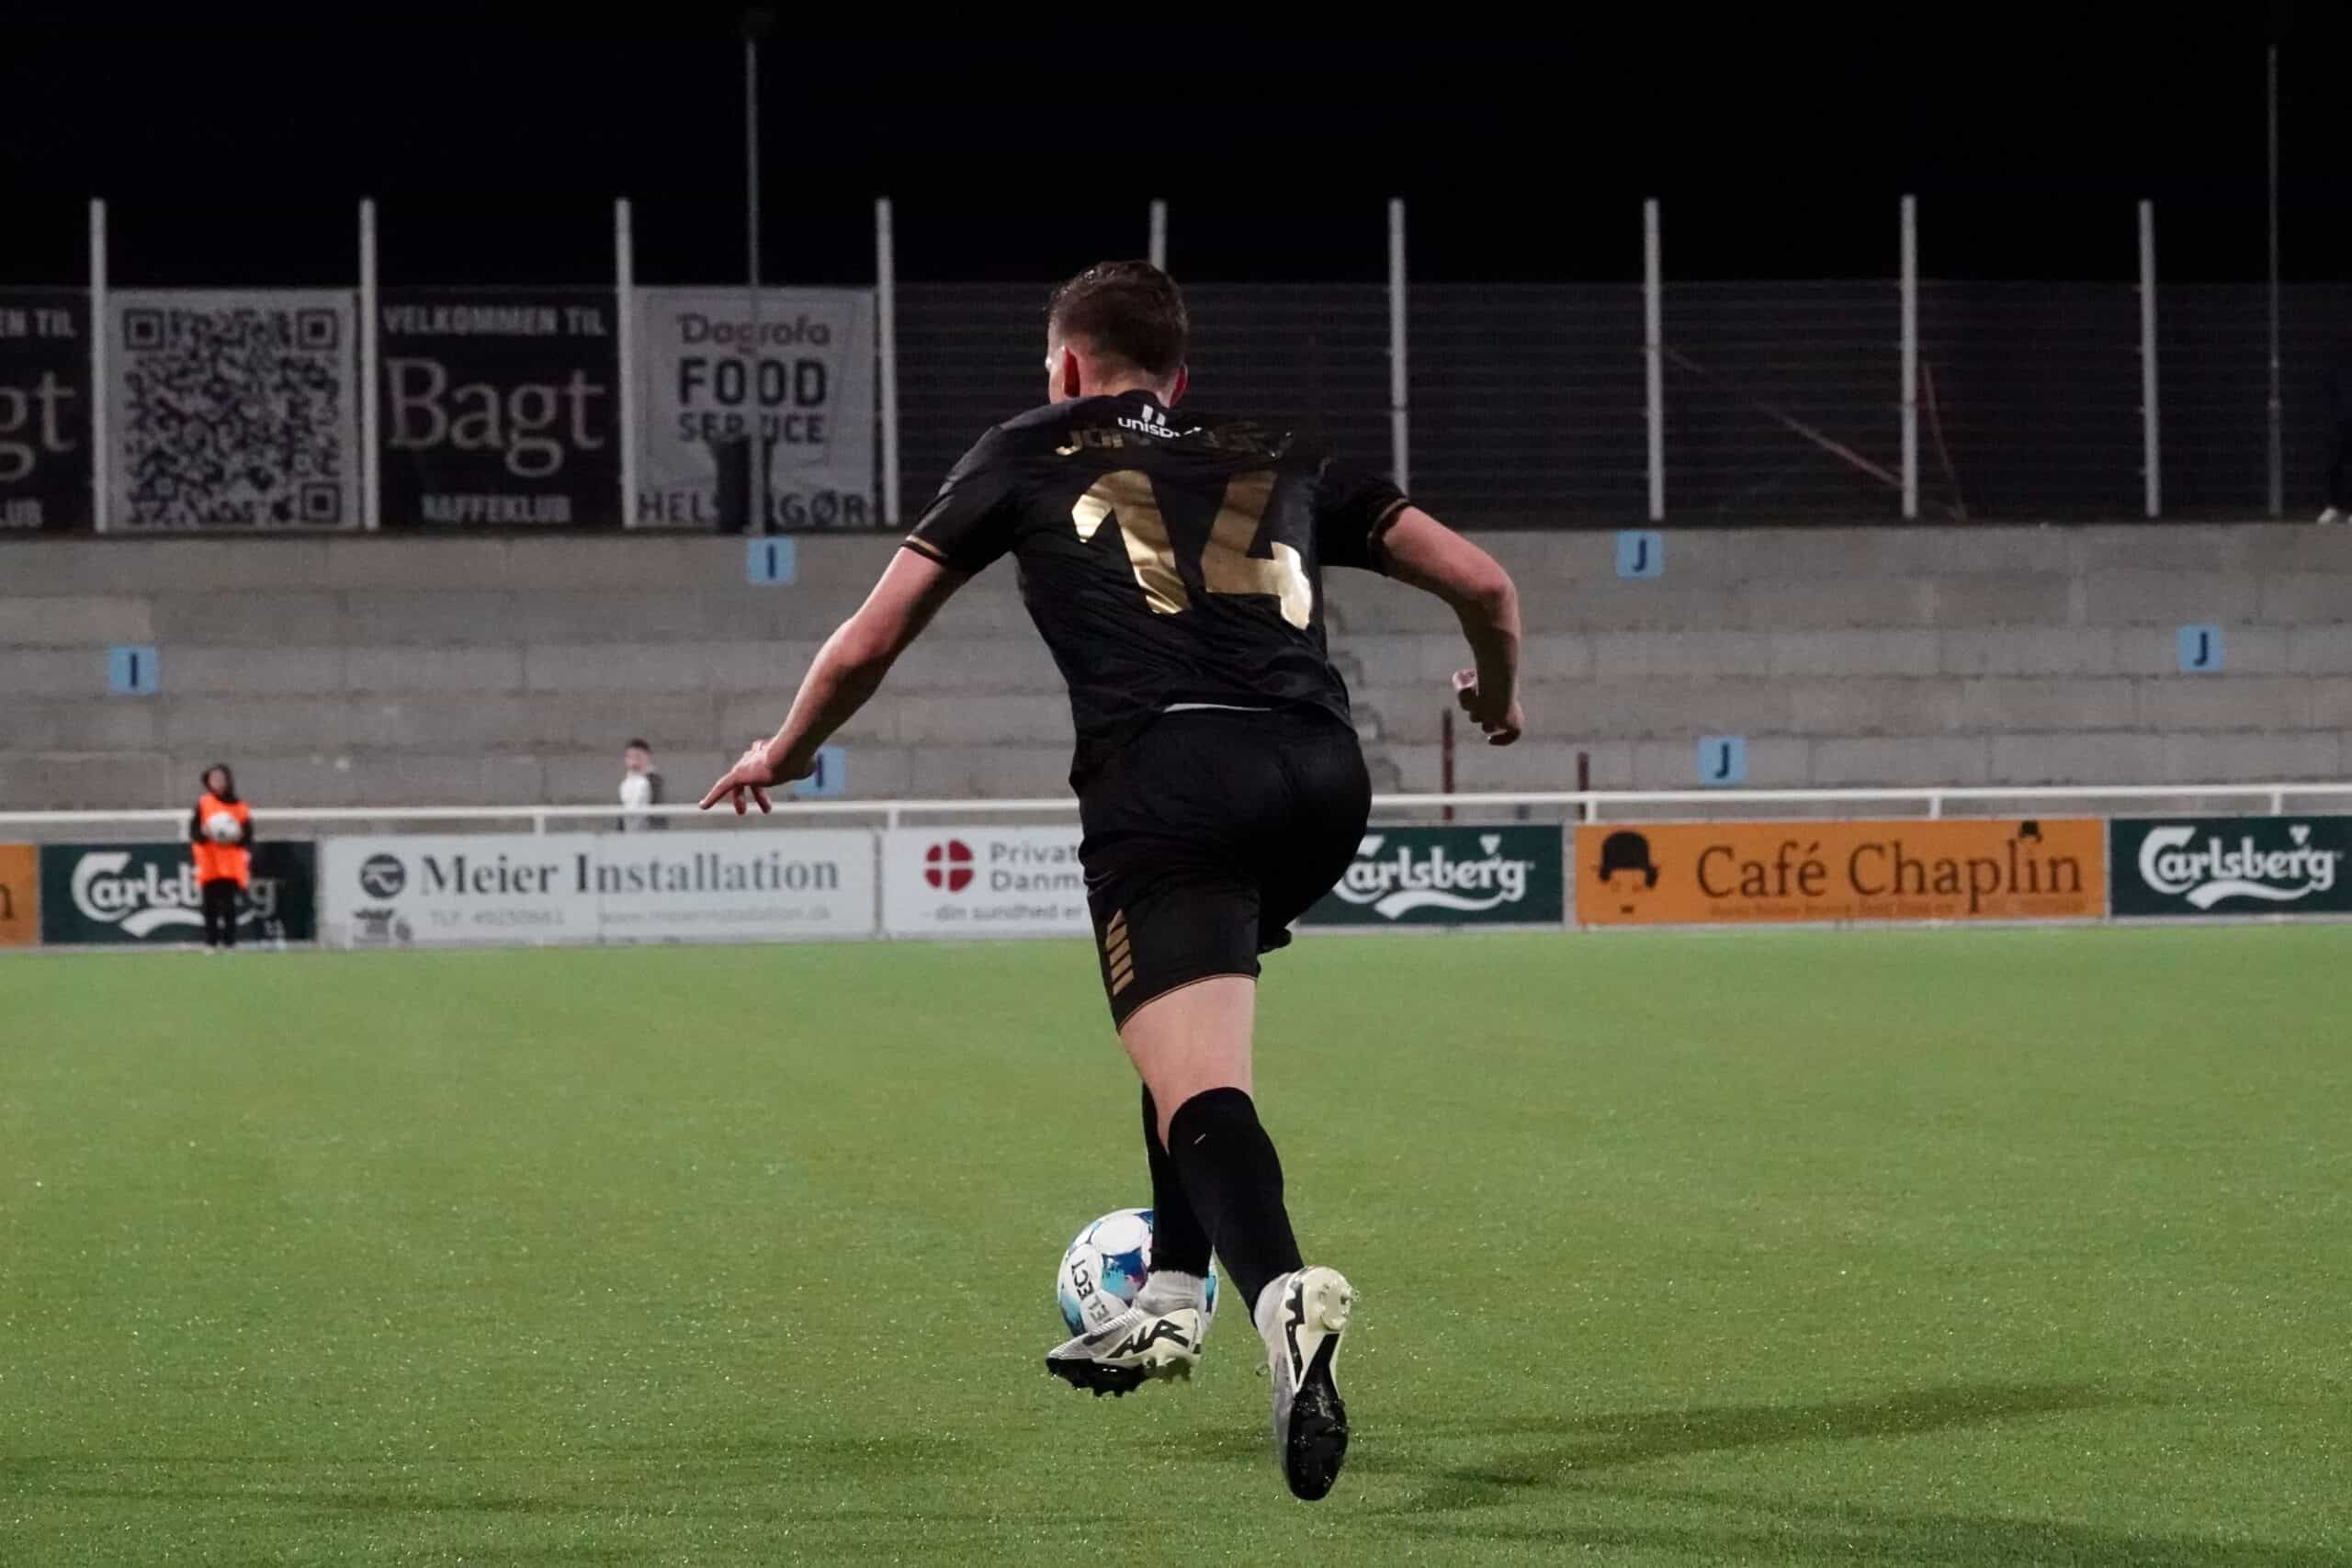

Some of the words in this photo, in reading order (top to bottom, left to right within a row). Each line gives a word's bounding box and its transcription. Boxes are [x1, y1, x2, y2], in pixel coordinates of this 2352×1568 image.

[382, 306, 559, 336] VELKOMMEN
[678, 356, 828, 408] FOOD
[383, 356, 605, 479] Bagt
[1071, 469, 1313, 630] 14
[1631, 538, 1647, 573] J
[2192, 631, 2209, 667] J
[1714, 742, 1731, 779] J
[420, 853, 559, 897] Meier
[574, 850, 841, 894] Installation
[989, 869, 1086, 892] Danm
[1697, 839, 1827, 899] Café
[1848, 834, 2083, 914] Chaplin
[2138, 826, 2335, 895] Carlsberg
[71, 852, 277, 922] Carlsbg
[1069, 1258, 1113, 1324] ELECT
